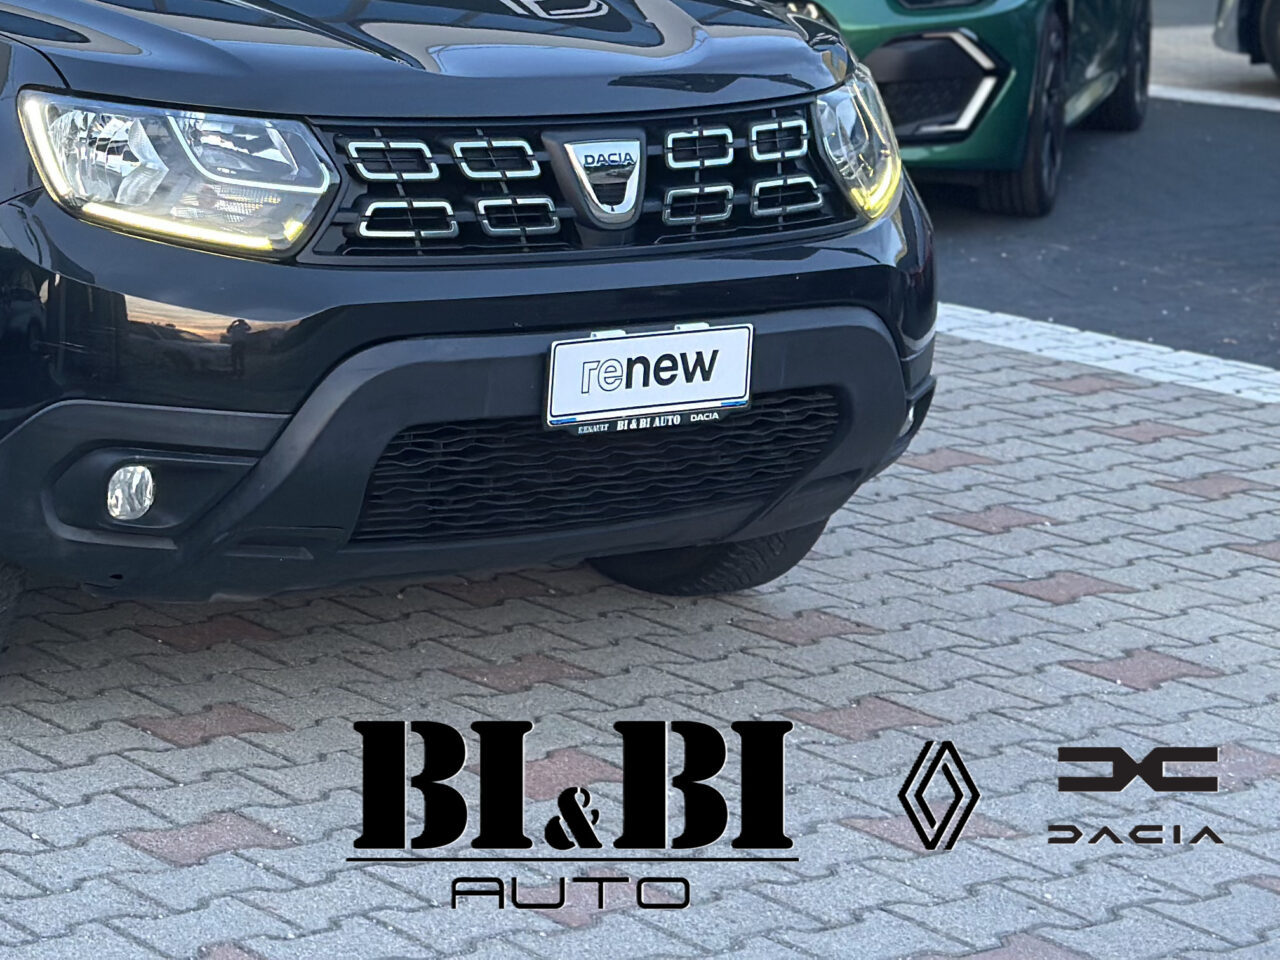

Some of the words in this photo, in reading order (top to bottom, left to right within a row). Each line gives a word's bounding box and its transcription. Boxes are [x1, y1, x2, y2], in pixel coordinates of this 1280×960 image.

[583, 152, 634, 167] DACIA
[581, 349, 720, 395] renew
[578, 423, 610, 434] RENAULT
[652, 415, 681, 428] AUTO
[690, 412, 719, 422] DACIA
